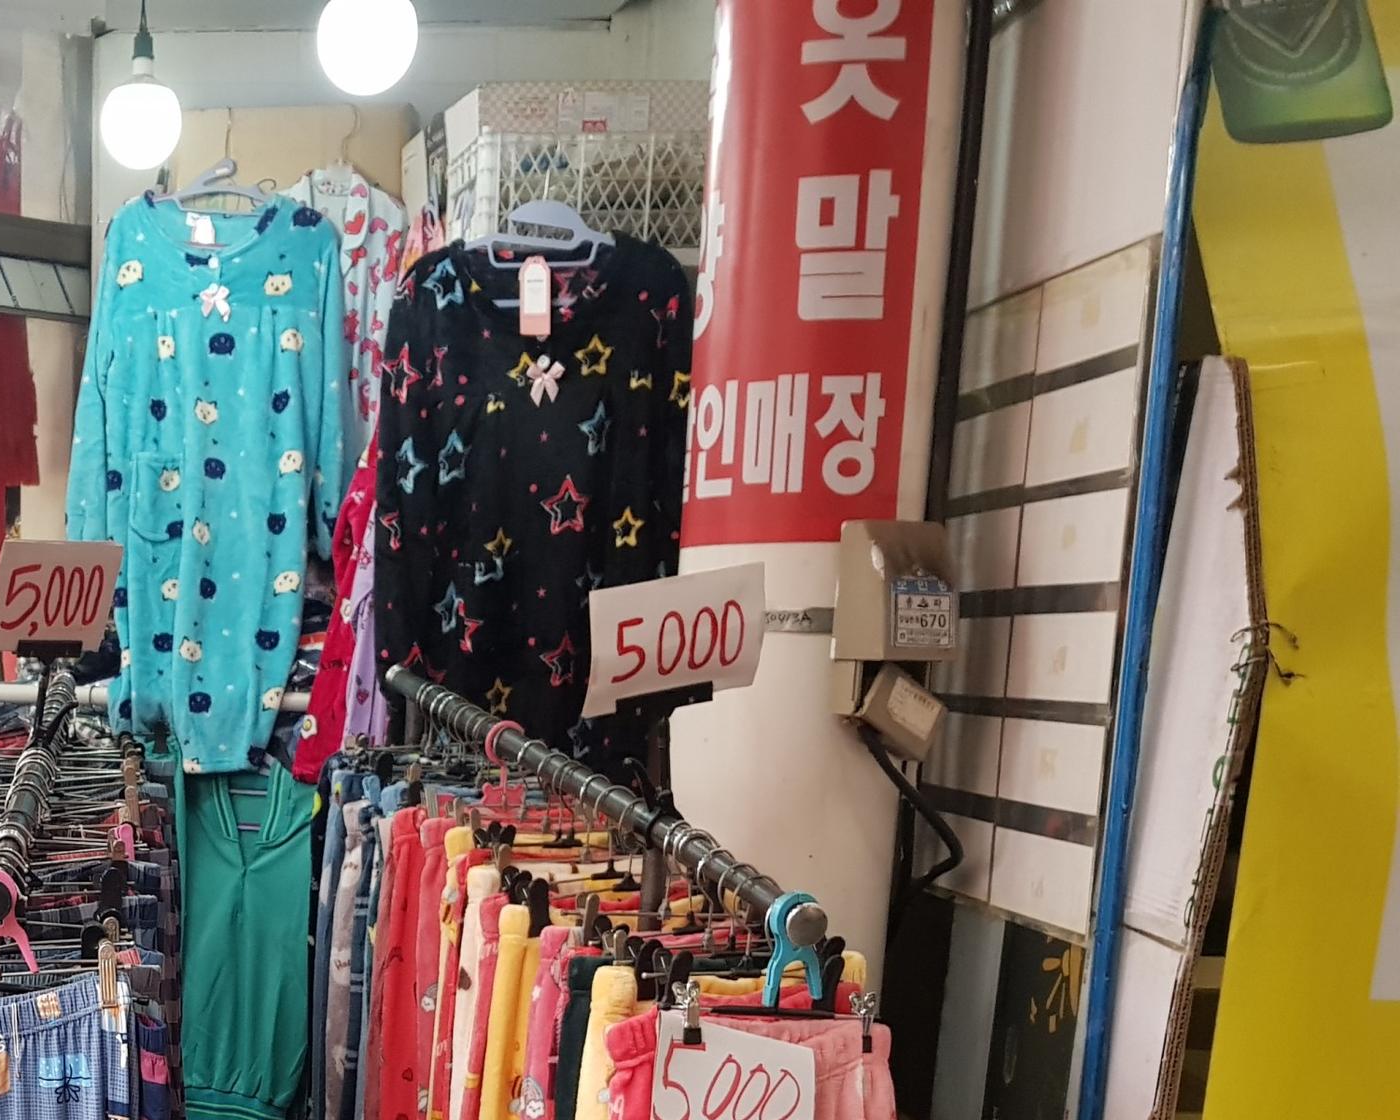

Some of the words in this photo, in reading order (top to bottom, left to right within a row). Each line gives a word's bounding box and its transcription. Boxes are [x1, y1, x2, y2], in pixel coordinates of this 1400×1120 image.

[795, 169, 901, 320] 말
[0, 563, 105, 638] 5,000
[919, 613, 947, 628] 670
[609, 598, 746, 687] 5000
